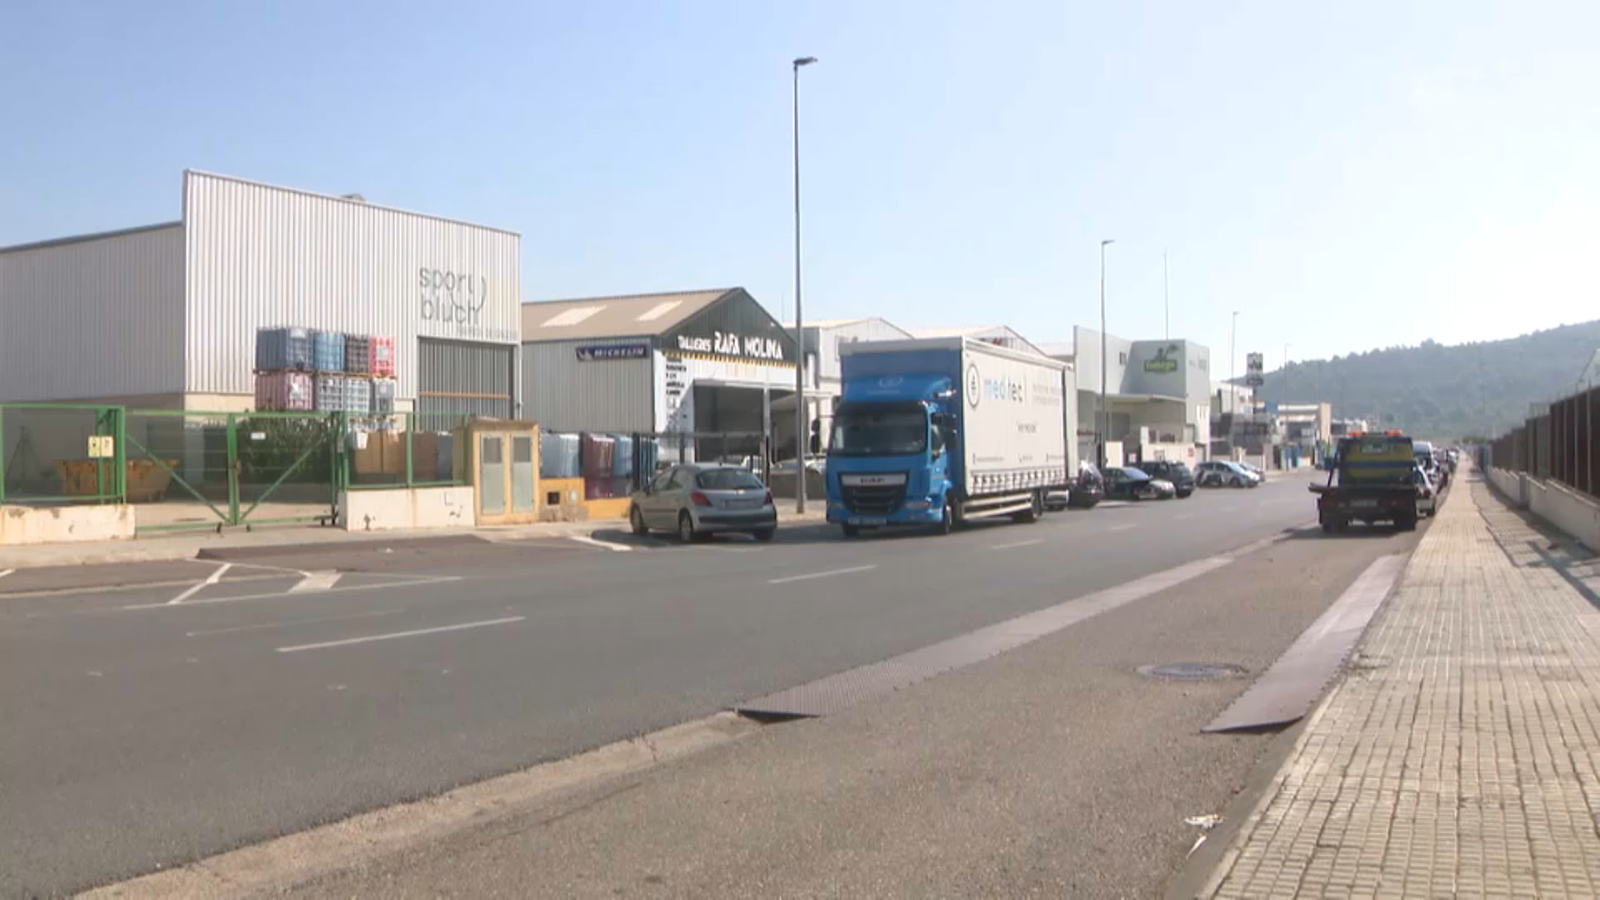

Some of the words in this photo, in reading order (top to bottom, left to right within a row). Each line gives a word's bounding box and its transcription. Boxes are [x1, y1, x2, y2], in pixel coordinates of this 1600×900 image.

[593, 347, 645, 357] MICHELIN
[713, 330, 741, 355] RAFA
[743, 336, 784, 361] MOLINA
